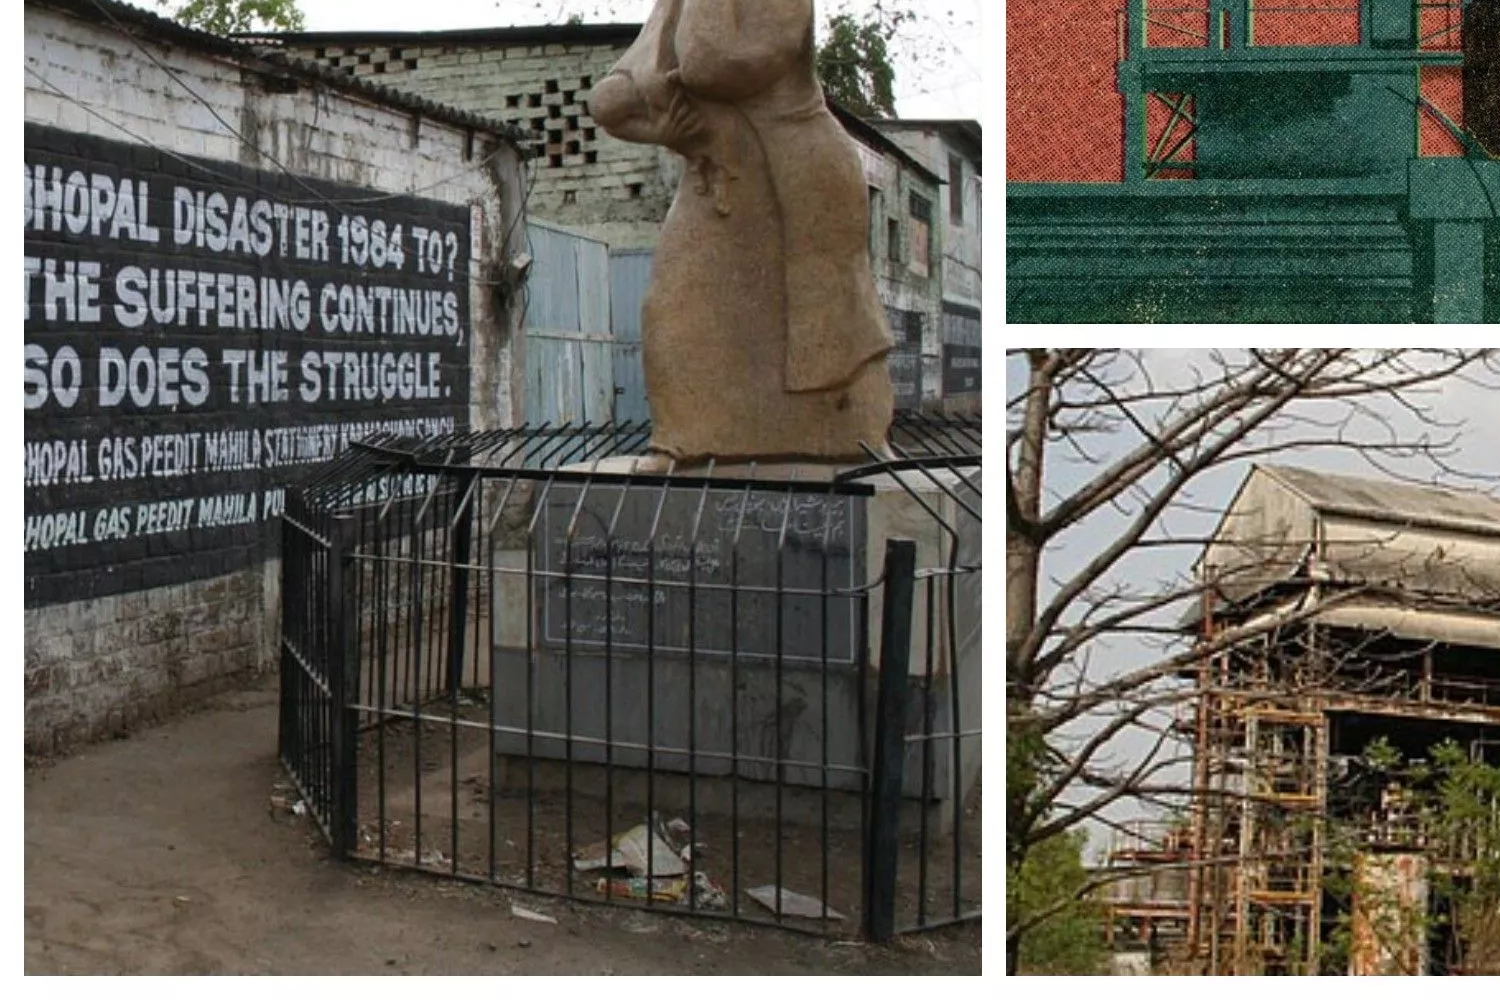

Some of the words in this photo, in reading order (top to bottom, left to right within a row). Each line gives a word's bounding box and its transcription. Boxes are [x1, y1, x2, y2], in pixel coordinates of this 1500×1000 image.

[174, 186, 330, 262] DISASTER
[337, 214, 405, 271] 1984
[412, 226, 458, 282] TO?
[24, 256, 101, 323] THE
[114, 265, 311, 332] SUFFERING
[320, 282, 465, 347] CONTINUES,
[24, 343, 82, 410] SO
[99, 346, 210, 407] DOES
[222, 350, 288, 404] THE
[300, 351, 451, 403] STRUGGLE.
[24, 439, 94, 487] HOPAL
[98, 437, 138, 481] GAS
[141, 433, 202, 477] PEEDIT
[204, 429, 261, 472] MAHILA
[24, 511, 88, 552] HOPAL
[93, 507, 131, 541] GAS
[136, 499, 195, 536] PEEDIT
[198, 492, 257, 528] MAHILA
